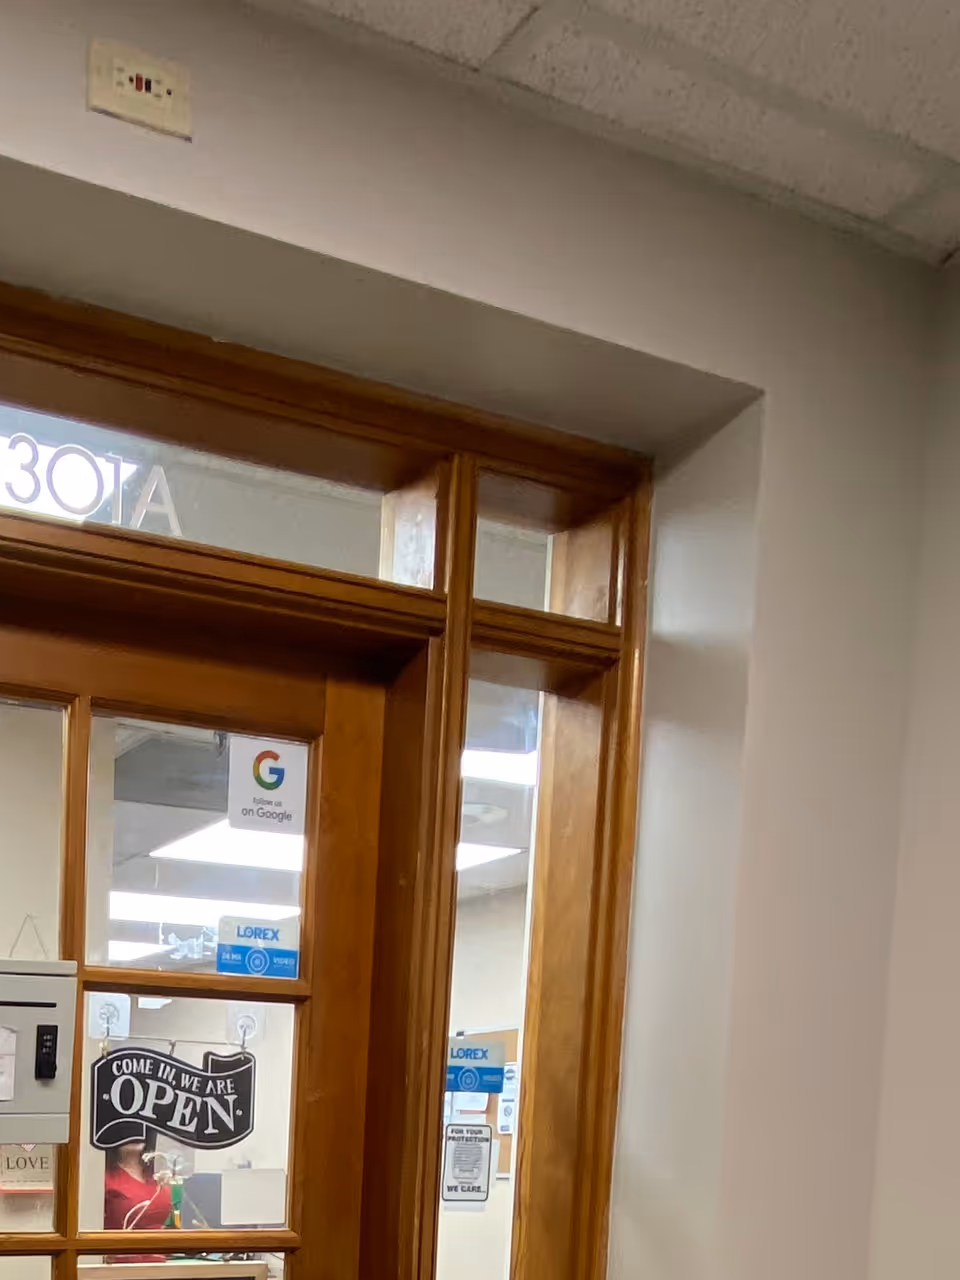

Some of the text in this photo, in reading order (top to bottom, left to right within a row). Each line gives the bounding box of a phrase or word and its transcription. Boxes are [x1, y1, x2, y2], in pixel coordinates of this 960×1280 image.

[5, 432, 183, 537] 301A
[241, 808, 292, 822] on Google
[237, 925, 279, 941] LOREX
[450, 1047, 488, 1060] LOREX
[112, 1058, 235, 1094] COME IN, WE ARE
[110, 1075, 239, 1135] OPEN
[6, 1156, 49, 1170] LOVE
